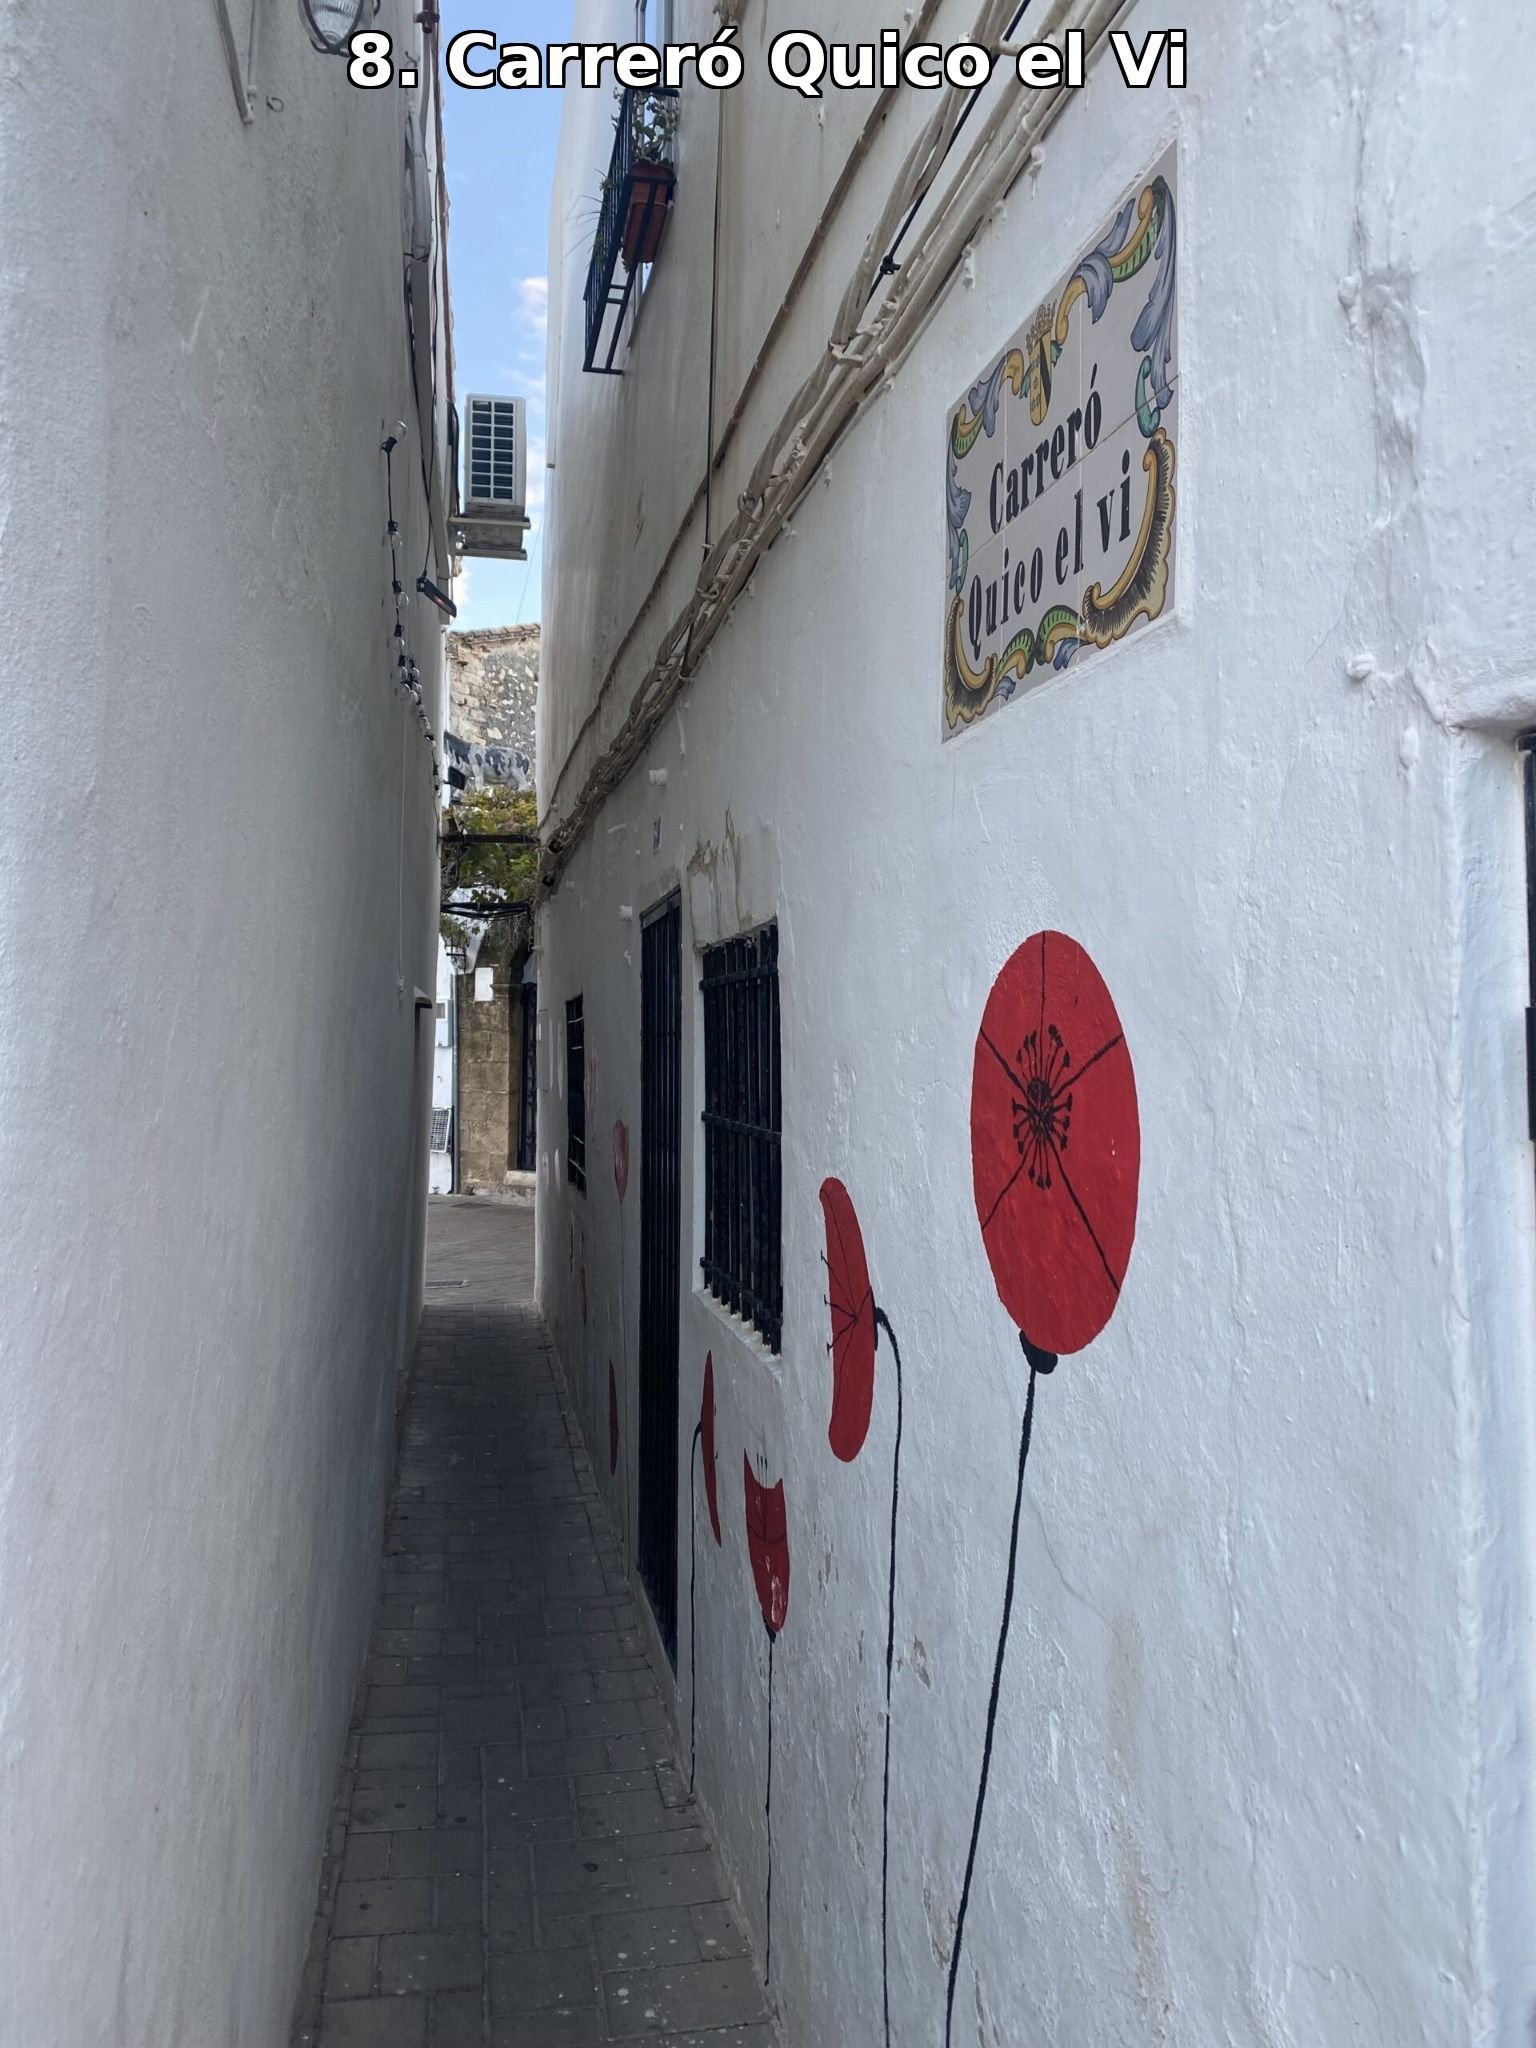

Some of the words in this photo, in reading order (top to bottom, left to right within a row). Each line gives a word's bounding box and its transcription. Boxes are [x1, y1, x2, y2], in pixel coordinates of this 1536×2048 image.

[989, 362, 1102, 535] Carreró
[968, 547, 1044, 662] Quico
[1055, 488, 1084, 586] el
[1096, 449, 1131, 553] vi
